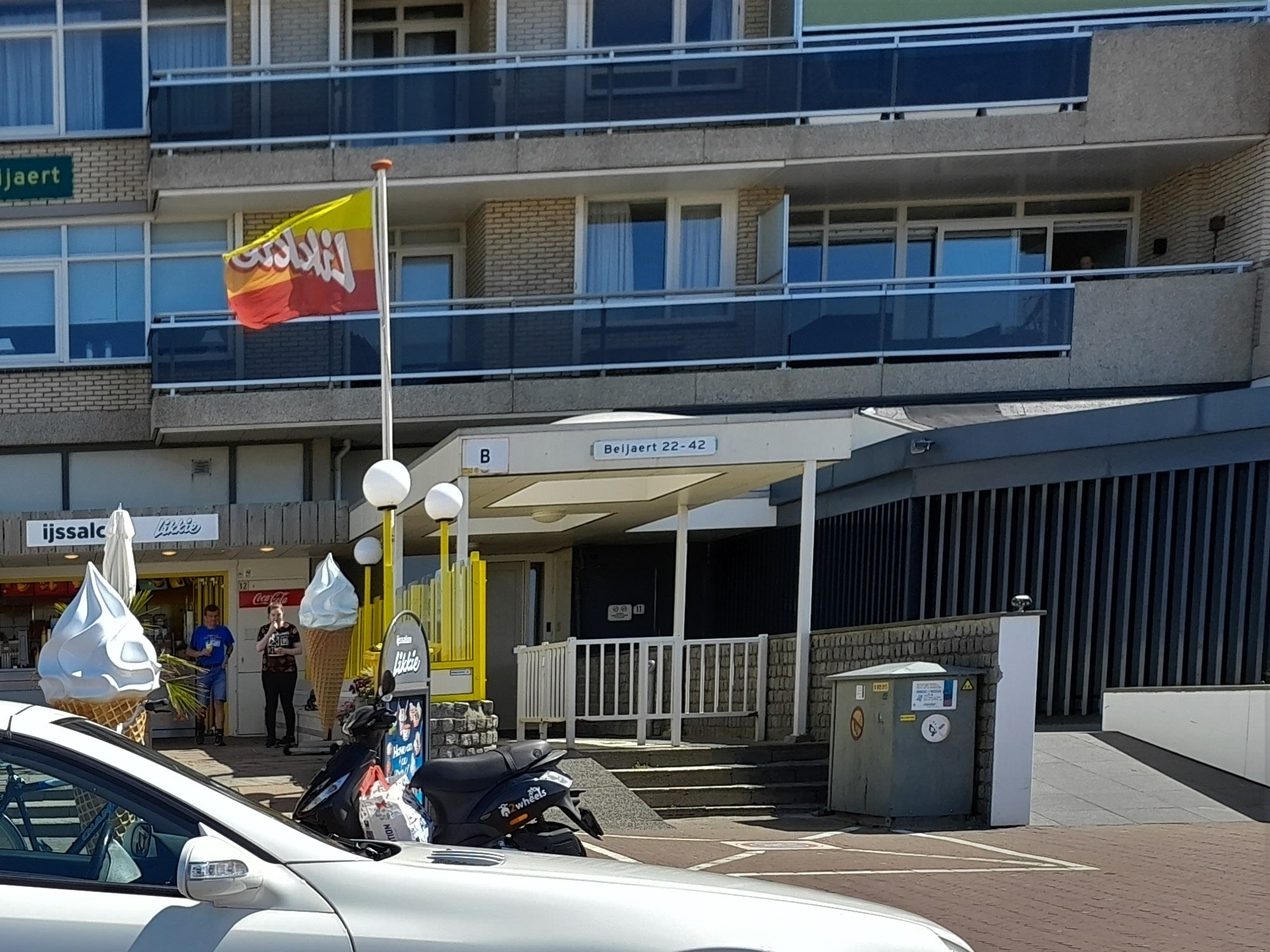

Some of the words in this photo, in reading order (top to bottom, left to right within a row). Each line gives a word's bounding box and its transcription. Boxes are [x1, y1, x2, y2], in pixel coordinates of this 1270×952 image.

[480, 448, 490, 464] B
[604, 442, 657, 456] Beijaert
[662, 439, 706, 452] 22-42
[43, 522, 105, 543] ijssalo
[509, 788, 547, 813] 2wheels
[383, 823, 399, 842] TION
